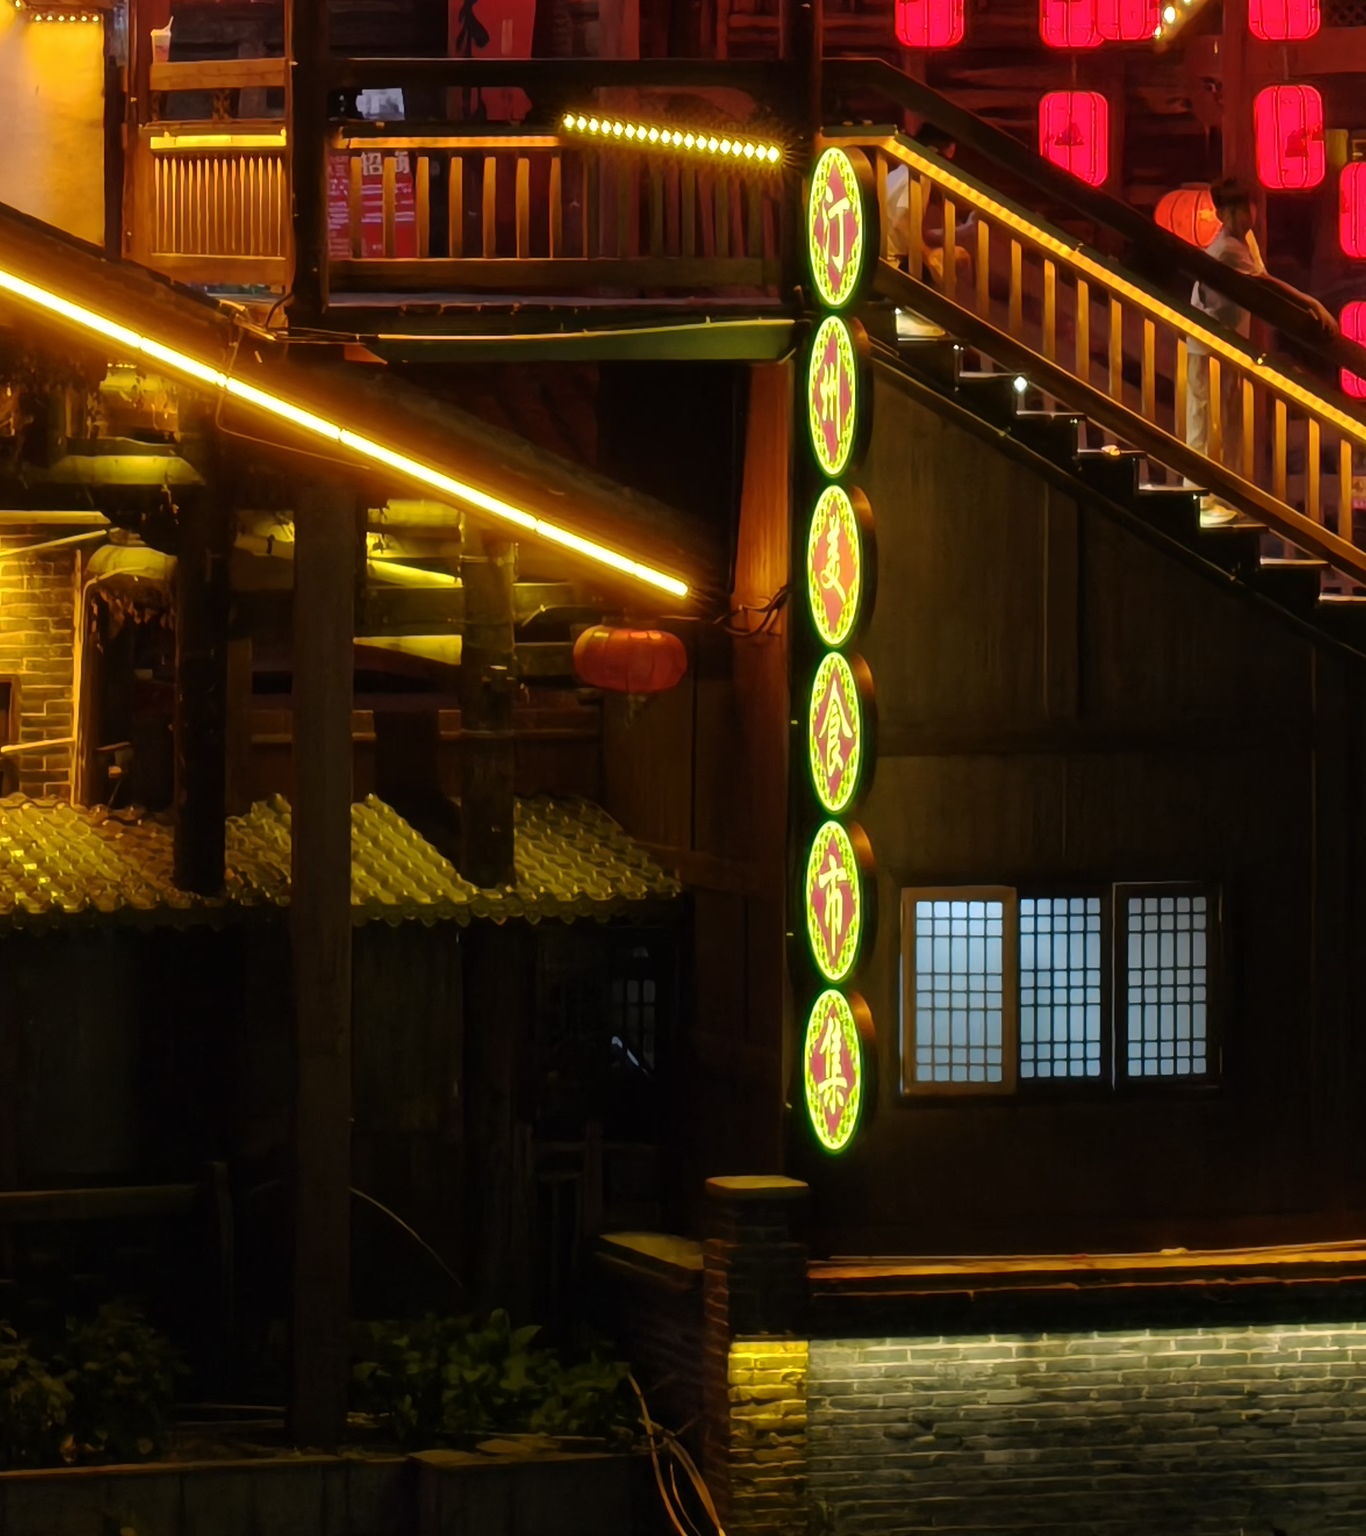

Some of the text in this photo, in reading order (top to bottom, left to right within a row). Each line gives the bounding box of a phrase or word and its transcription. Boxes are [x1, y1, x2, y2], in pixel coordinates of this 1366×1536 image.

[816, 182, 855, 1117] 汀州美食市集
